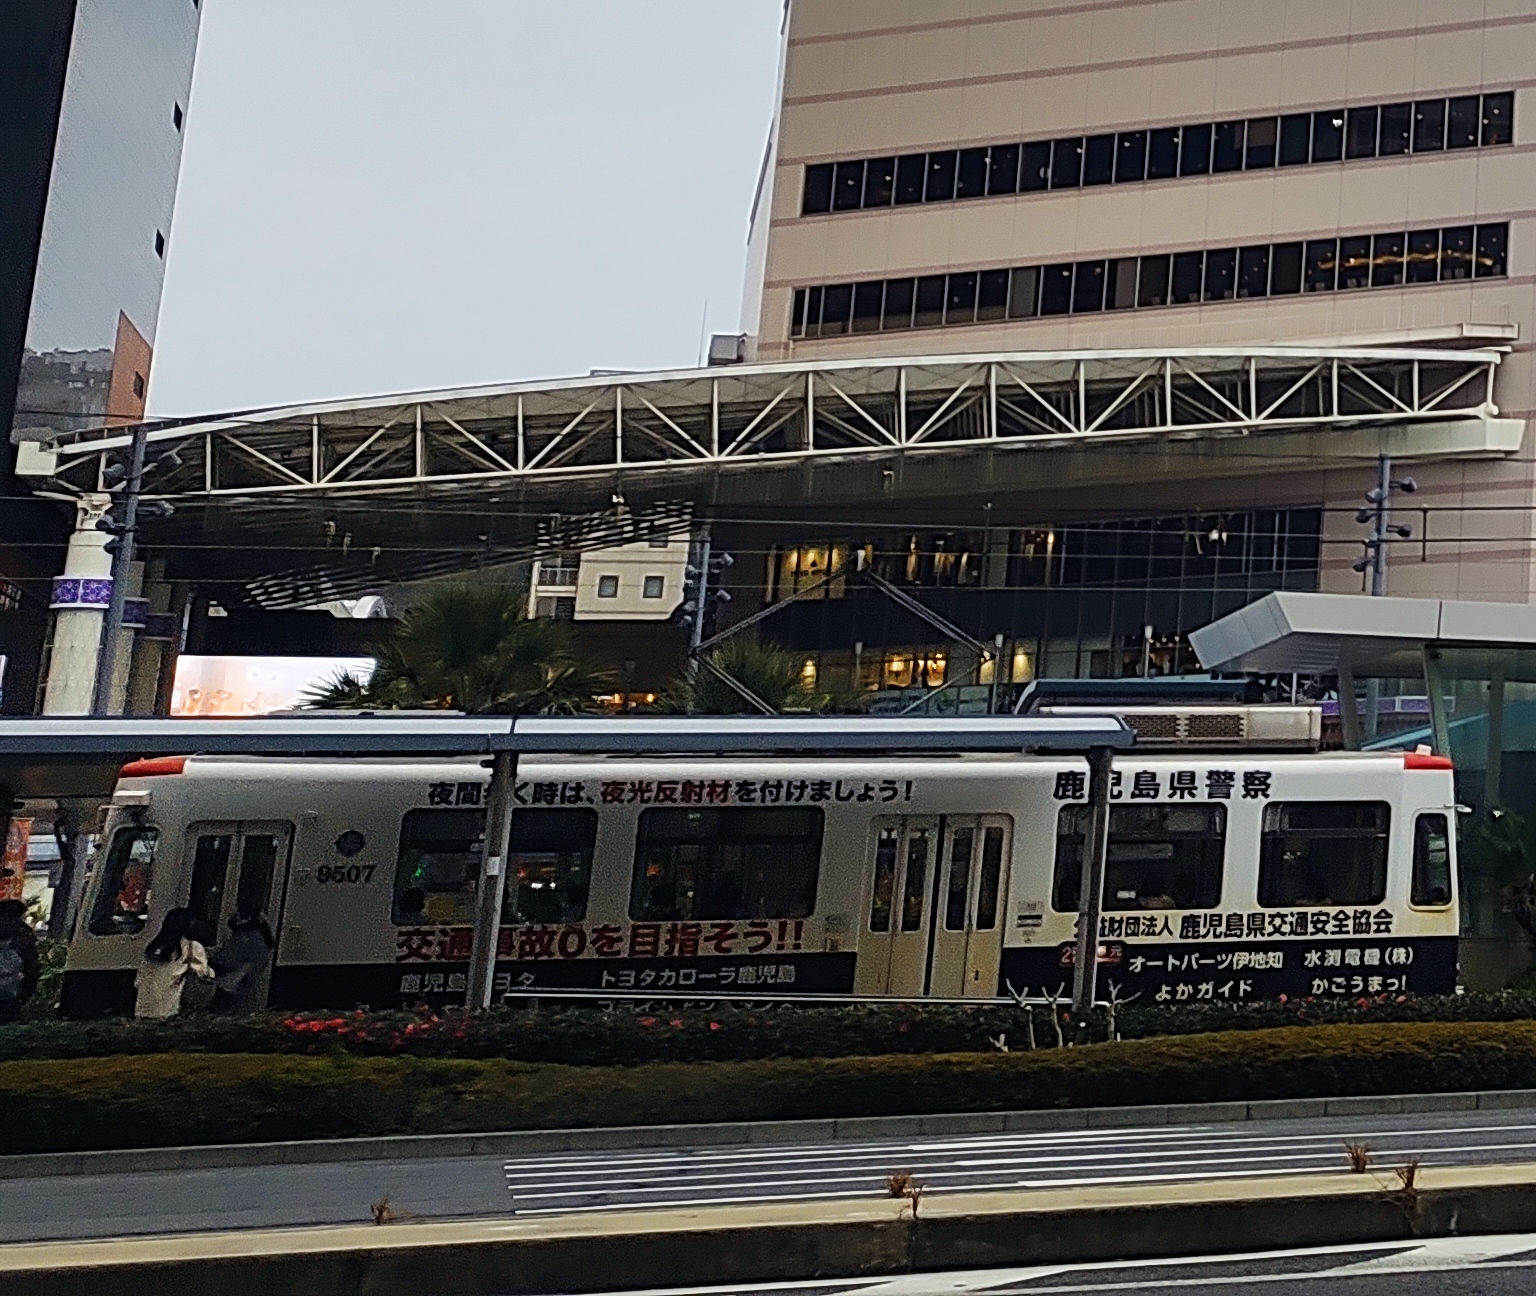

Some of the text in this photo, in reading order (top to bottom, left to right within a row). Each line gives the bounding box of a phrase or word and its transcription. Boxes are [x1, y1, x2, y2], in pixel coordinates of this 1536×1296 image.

[428, 779, 914, 806] 夜間く時は、夜光反射材を付けましょう!
[1073, 908, 1394, 940] 財団法人 鹿児島県交通安全協会
[399, 971, 536, 994] 鹿児島ヨタ
[601, 964, 797, 988] トヨタカローラ鹿児島
[1311, 974, 1408, 995] かごうまっ!
[1155, 979, 1254, 1002] よかガイド
